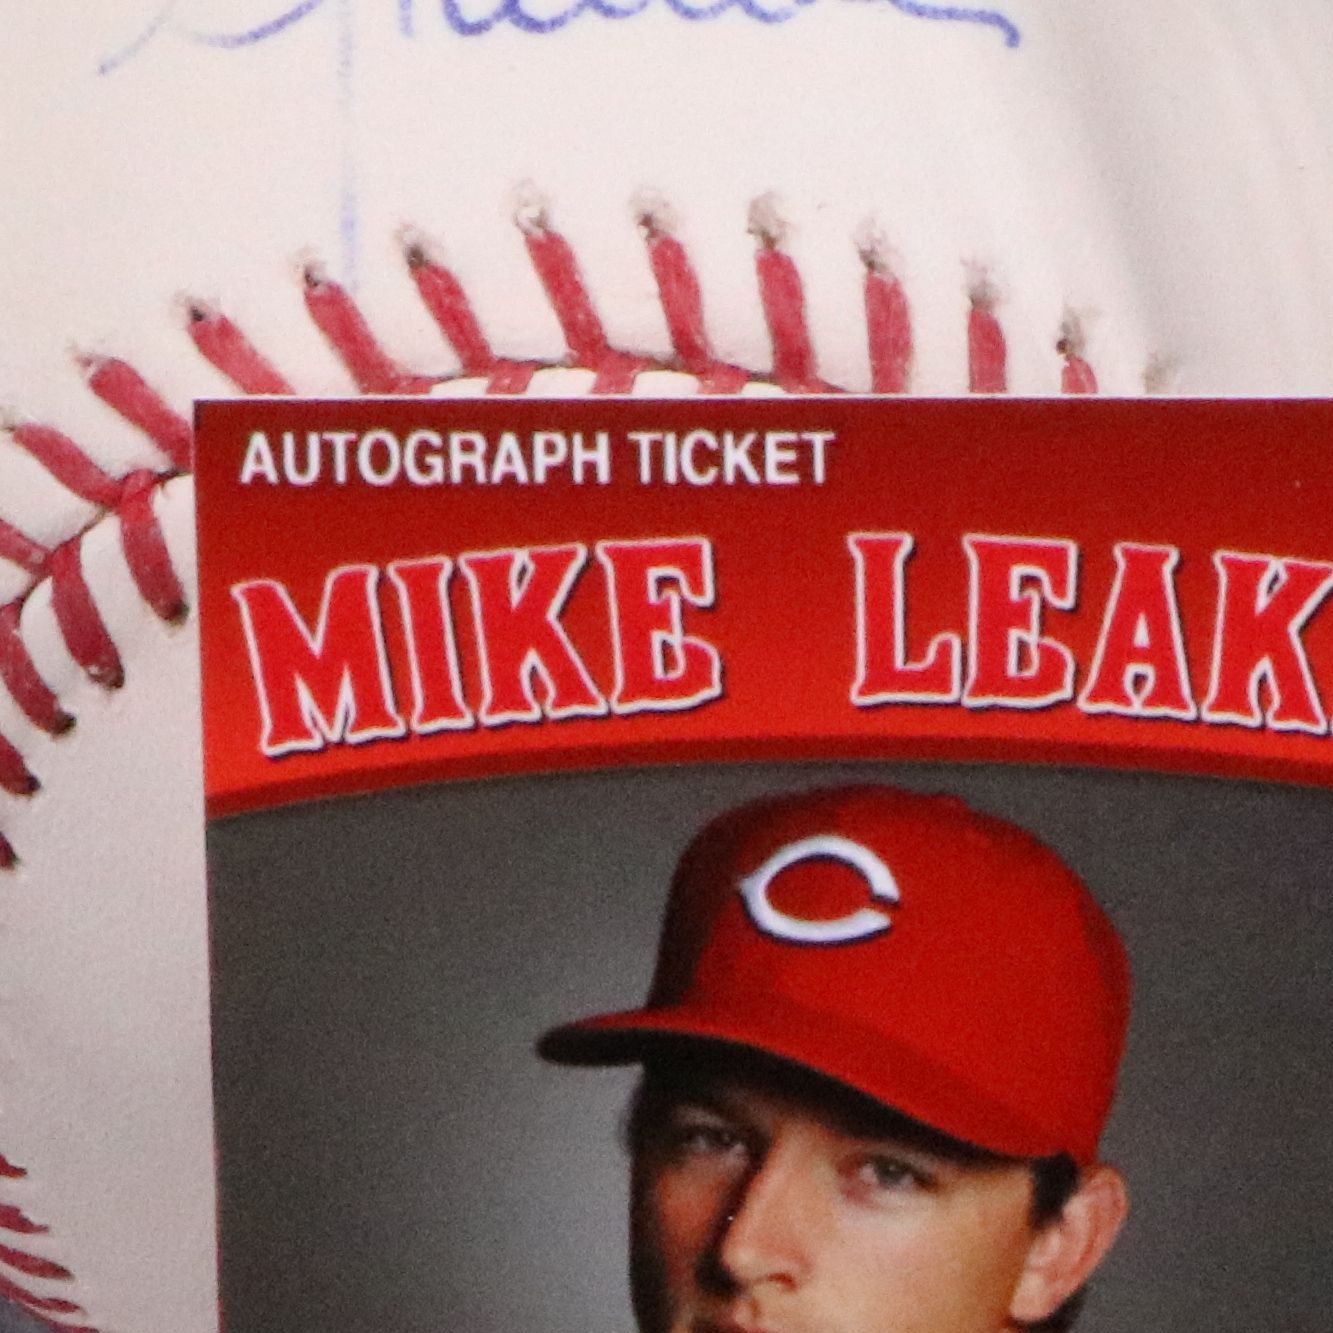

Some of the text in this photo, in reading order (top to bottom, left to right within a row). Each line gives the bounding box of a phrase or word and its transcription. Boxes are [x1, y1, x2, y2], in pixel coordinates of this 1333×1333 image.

[240, 430, 834, 485] AUTOGRAPH TICKET
[232, 536, 724, 756] MIKE
